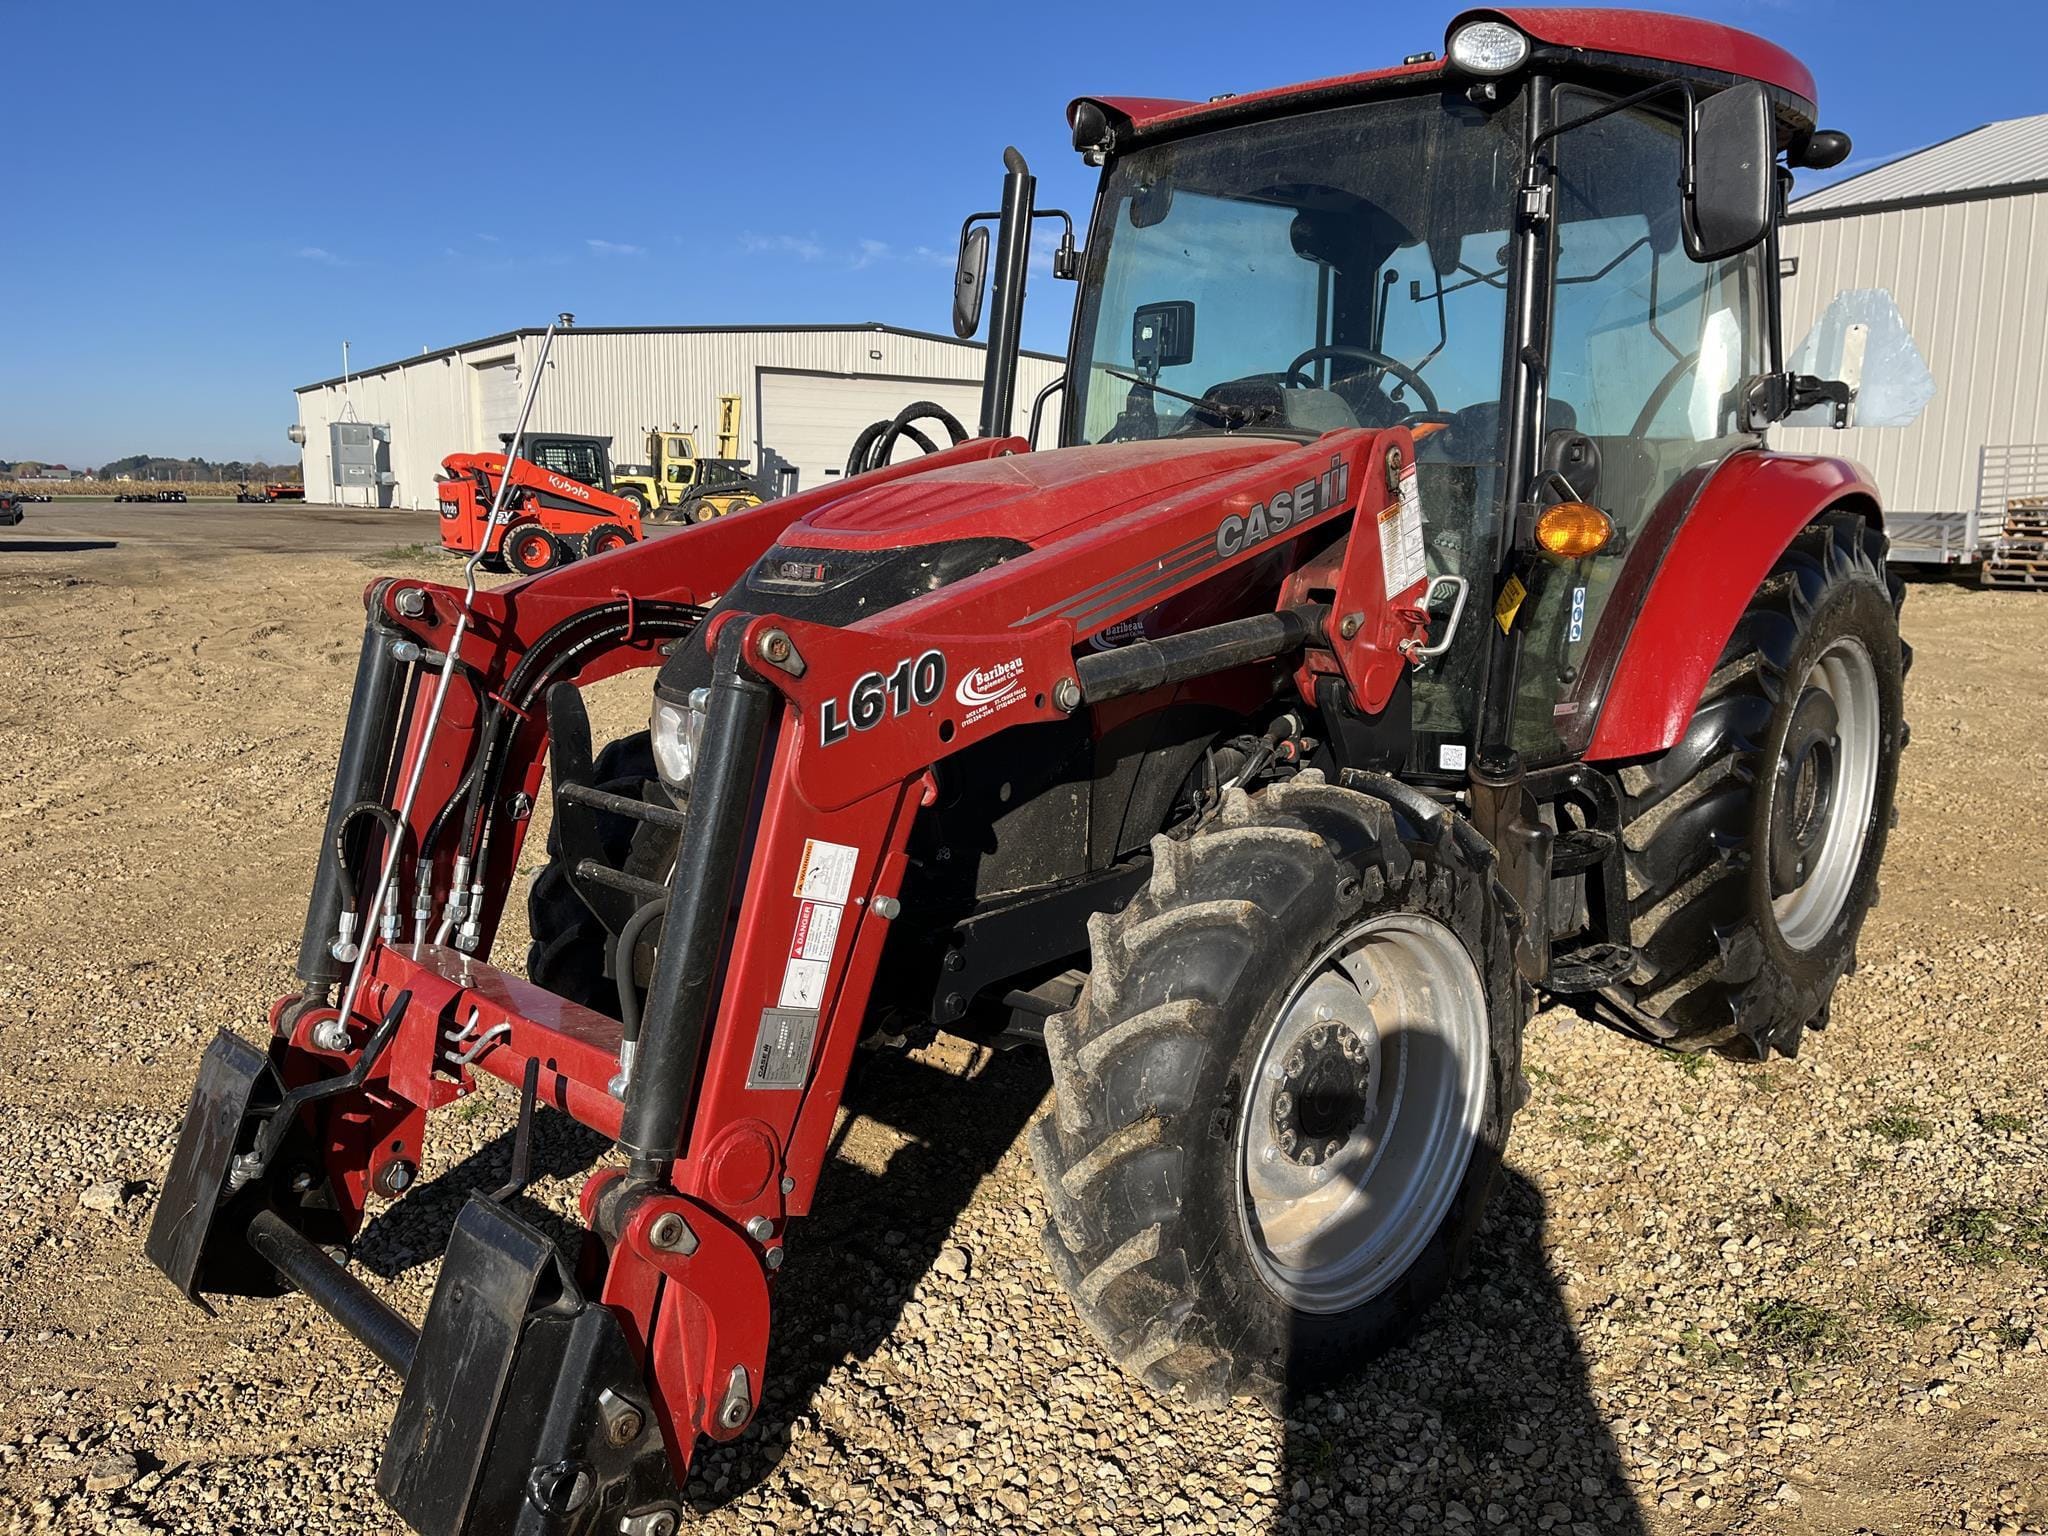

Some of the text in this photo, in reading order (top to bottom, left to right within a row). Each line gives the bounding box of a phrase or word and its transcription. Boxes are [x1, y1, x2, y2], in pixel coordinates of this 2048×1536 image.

[548, 475, 591, 500] Kubota
[1217, 478, 1316, 558] CASE
[975, 657, 1023, 686] Baribeau
[977, 675, 1006, 692] Implement
[821, 649, 946, 747] L610
[801, 844, 813, 881] WARNING
[797, 906, 811, 945] DANGER
[758, 1053, 768, 1078] CASE
